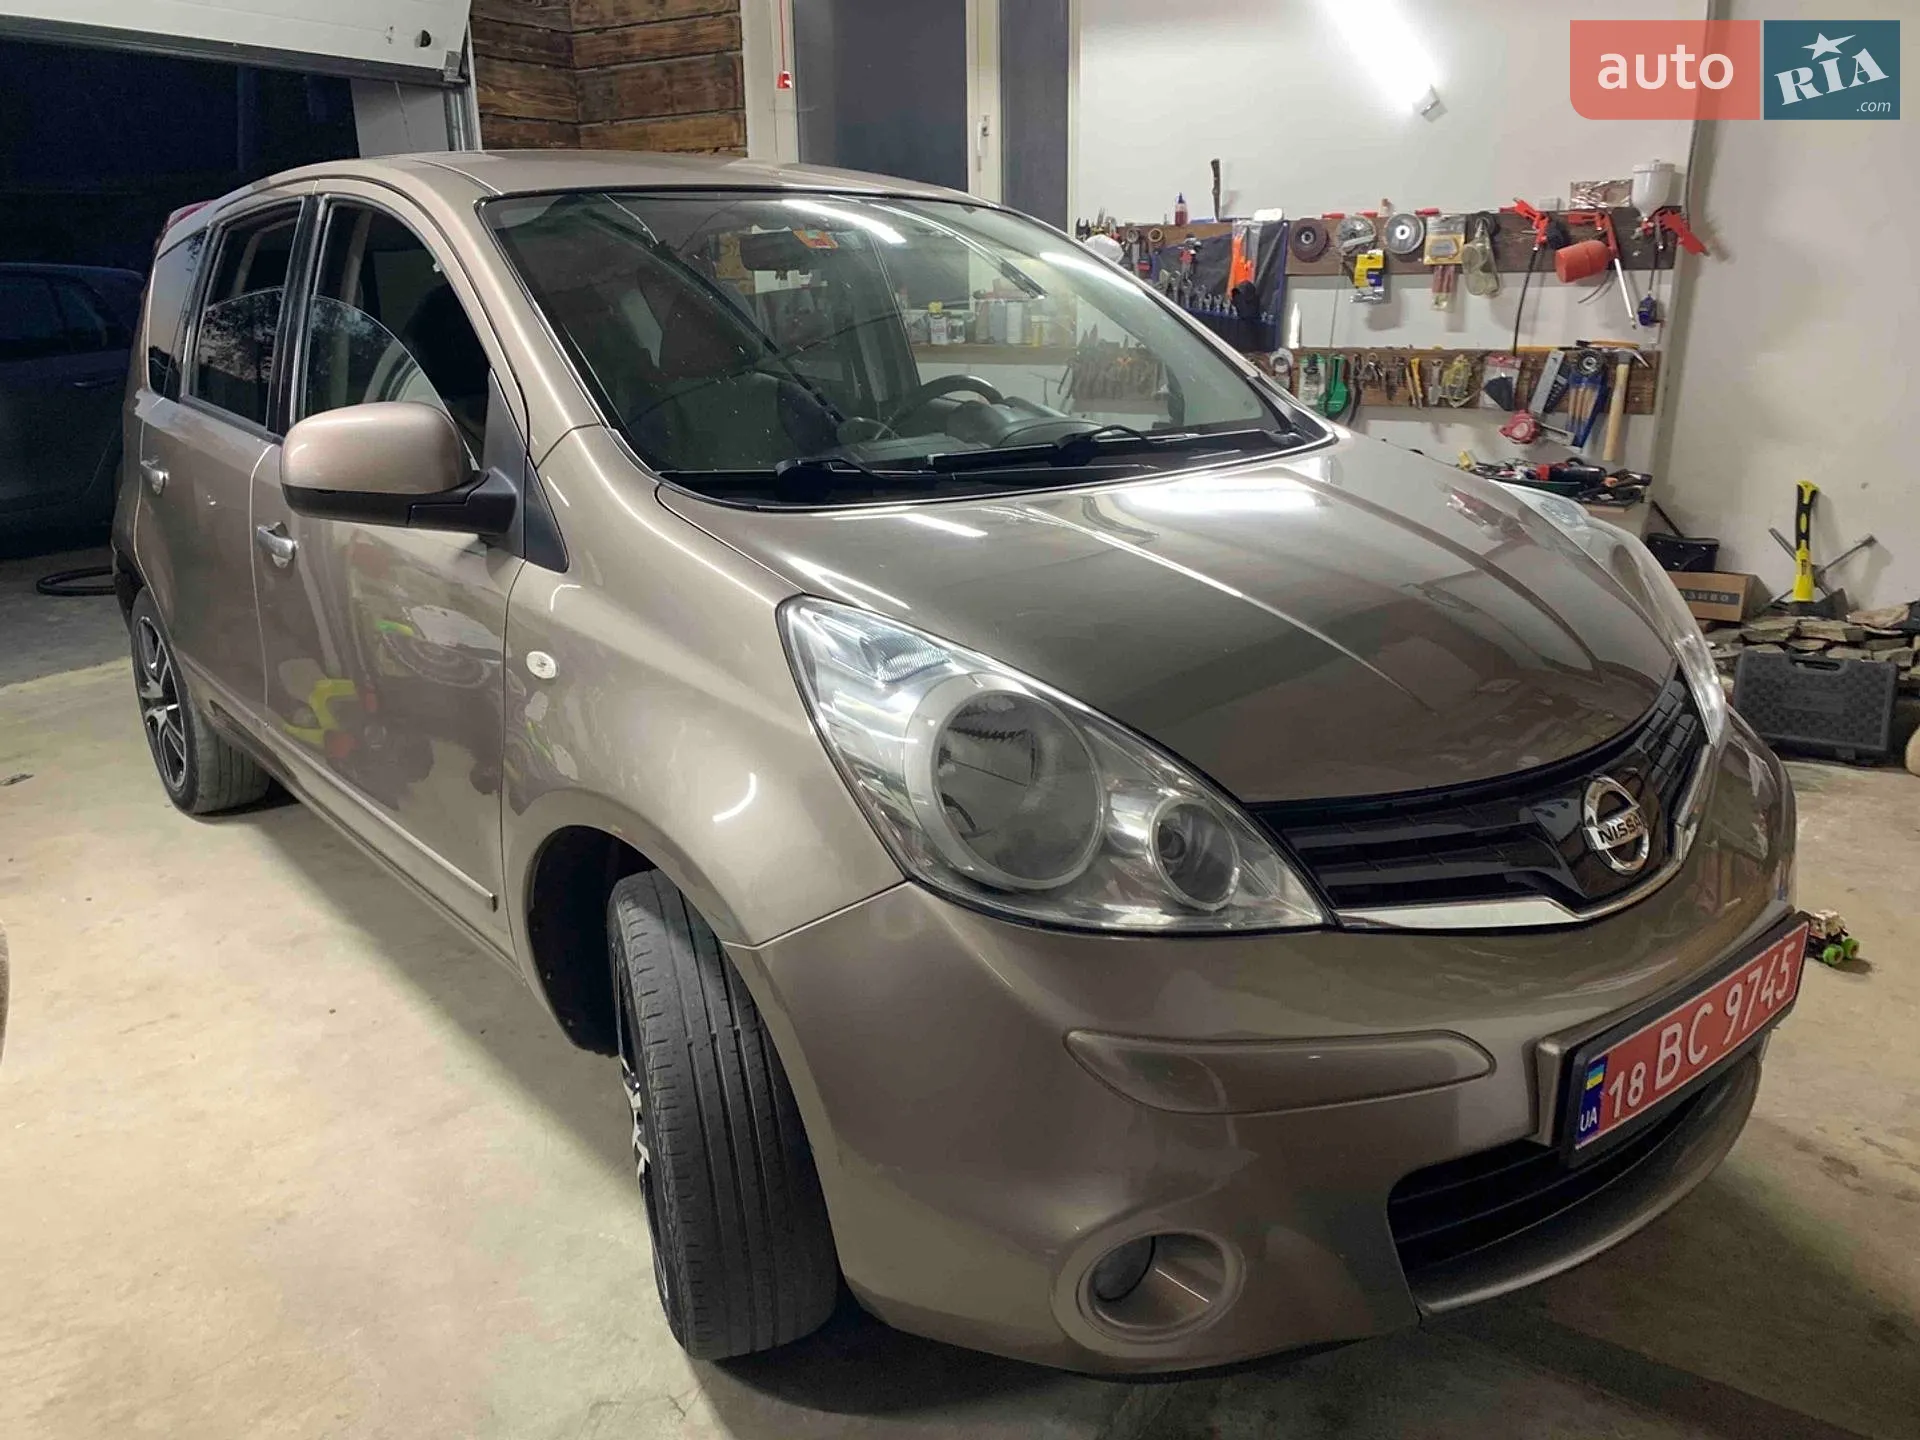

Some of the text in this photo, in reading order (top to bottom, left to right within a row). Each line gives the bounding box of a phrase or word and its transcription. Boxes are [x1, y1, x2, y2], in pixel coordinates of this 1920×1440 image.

[1608, 942, 1797, 1119] 18 BC 9745
[1579, 1106, 1598, 1132] UA
